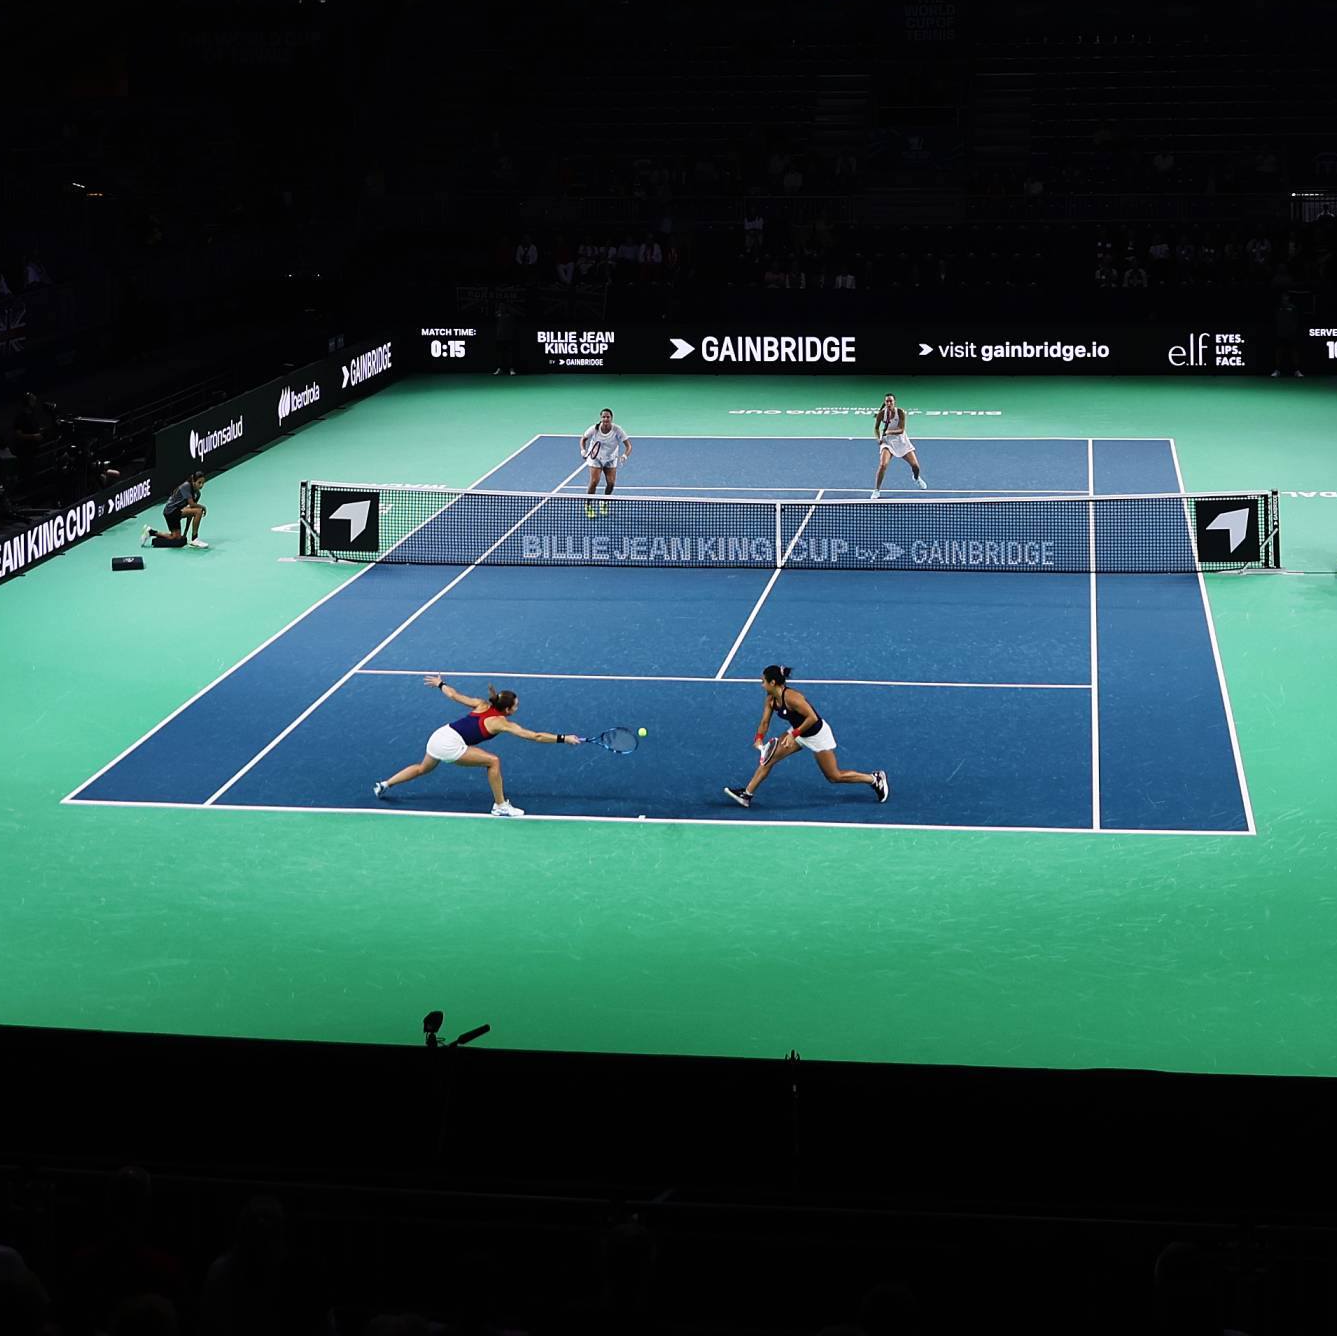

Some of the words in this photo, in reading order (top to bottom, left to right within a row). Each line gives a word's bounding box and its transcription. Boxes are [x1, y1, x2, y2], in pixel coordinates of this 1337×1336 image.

[537, 331, 577, 343] BILLIE
[579, 331, 615, 343] JEAN
[1216, 334, 1245, 343] EYES.
[431, 340, 465, 357] 0:15
[545, 343, 578, 354] KING
[580, 343, 608, 354] CUP
[702, 336, 855, 362] GAINBRIDGE
[939, 342, 977, 357] visit
[981, 342, 1109, 361] gainbridge.io
[1216, 346, 1242, 354] LIPS.
[350, 342, 392, 386] GAINBRIDGE
[1216, 357, 1245, 366] FACE.
[291, 382, 320, 412] Iberdrola
[198, 415, 243, 462] quirónsalud
[116, 479, 151, 512] GAINBRIDGE
[28, 516, 65, 564] KING
[66, 500, 96, 542] CUP
[522, 535, 610, 559] BILLIE
[613, 536, 690, 560] JEAN
[691, 536, 773, 561] KING
[787, 537, 848, 562] CUP
[856, 545, 879, 564] by
[912, 540, 1054, 565] GAINBRIDGE
